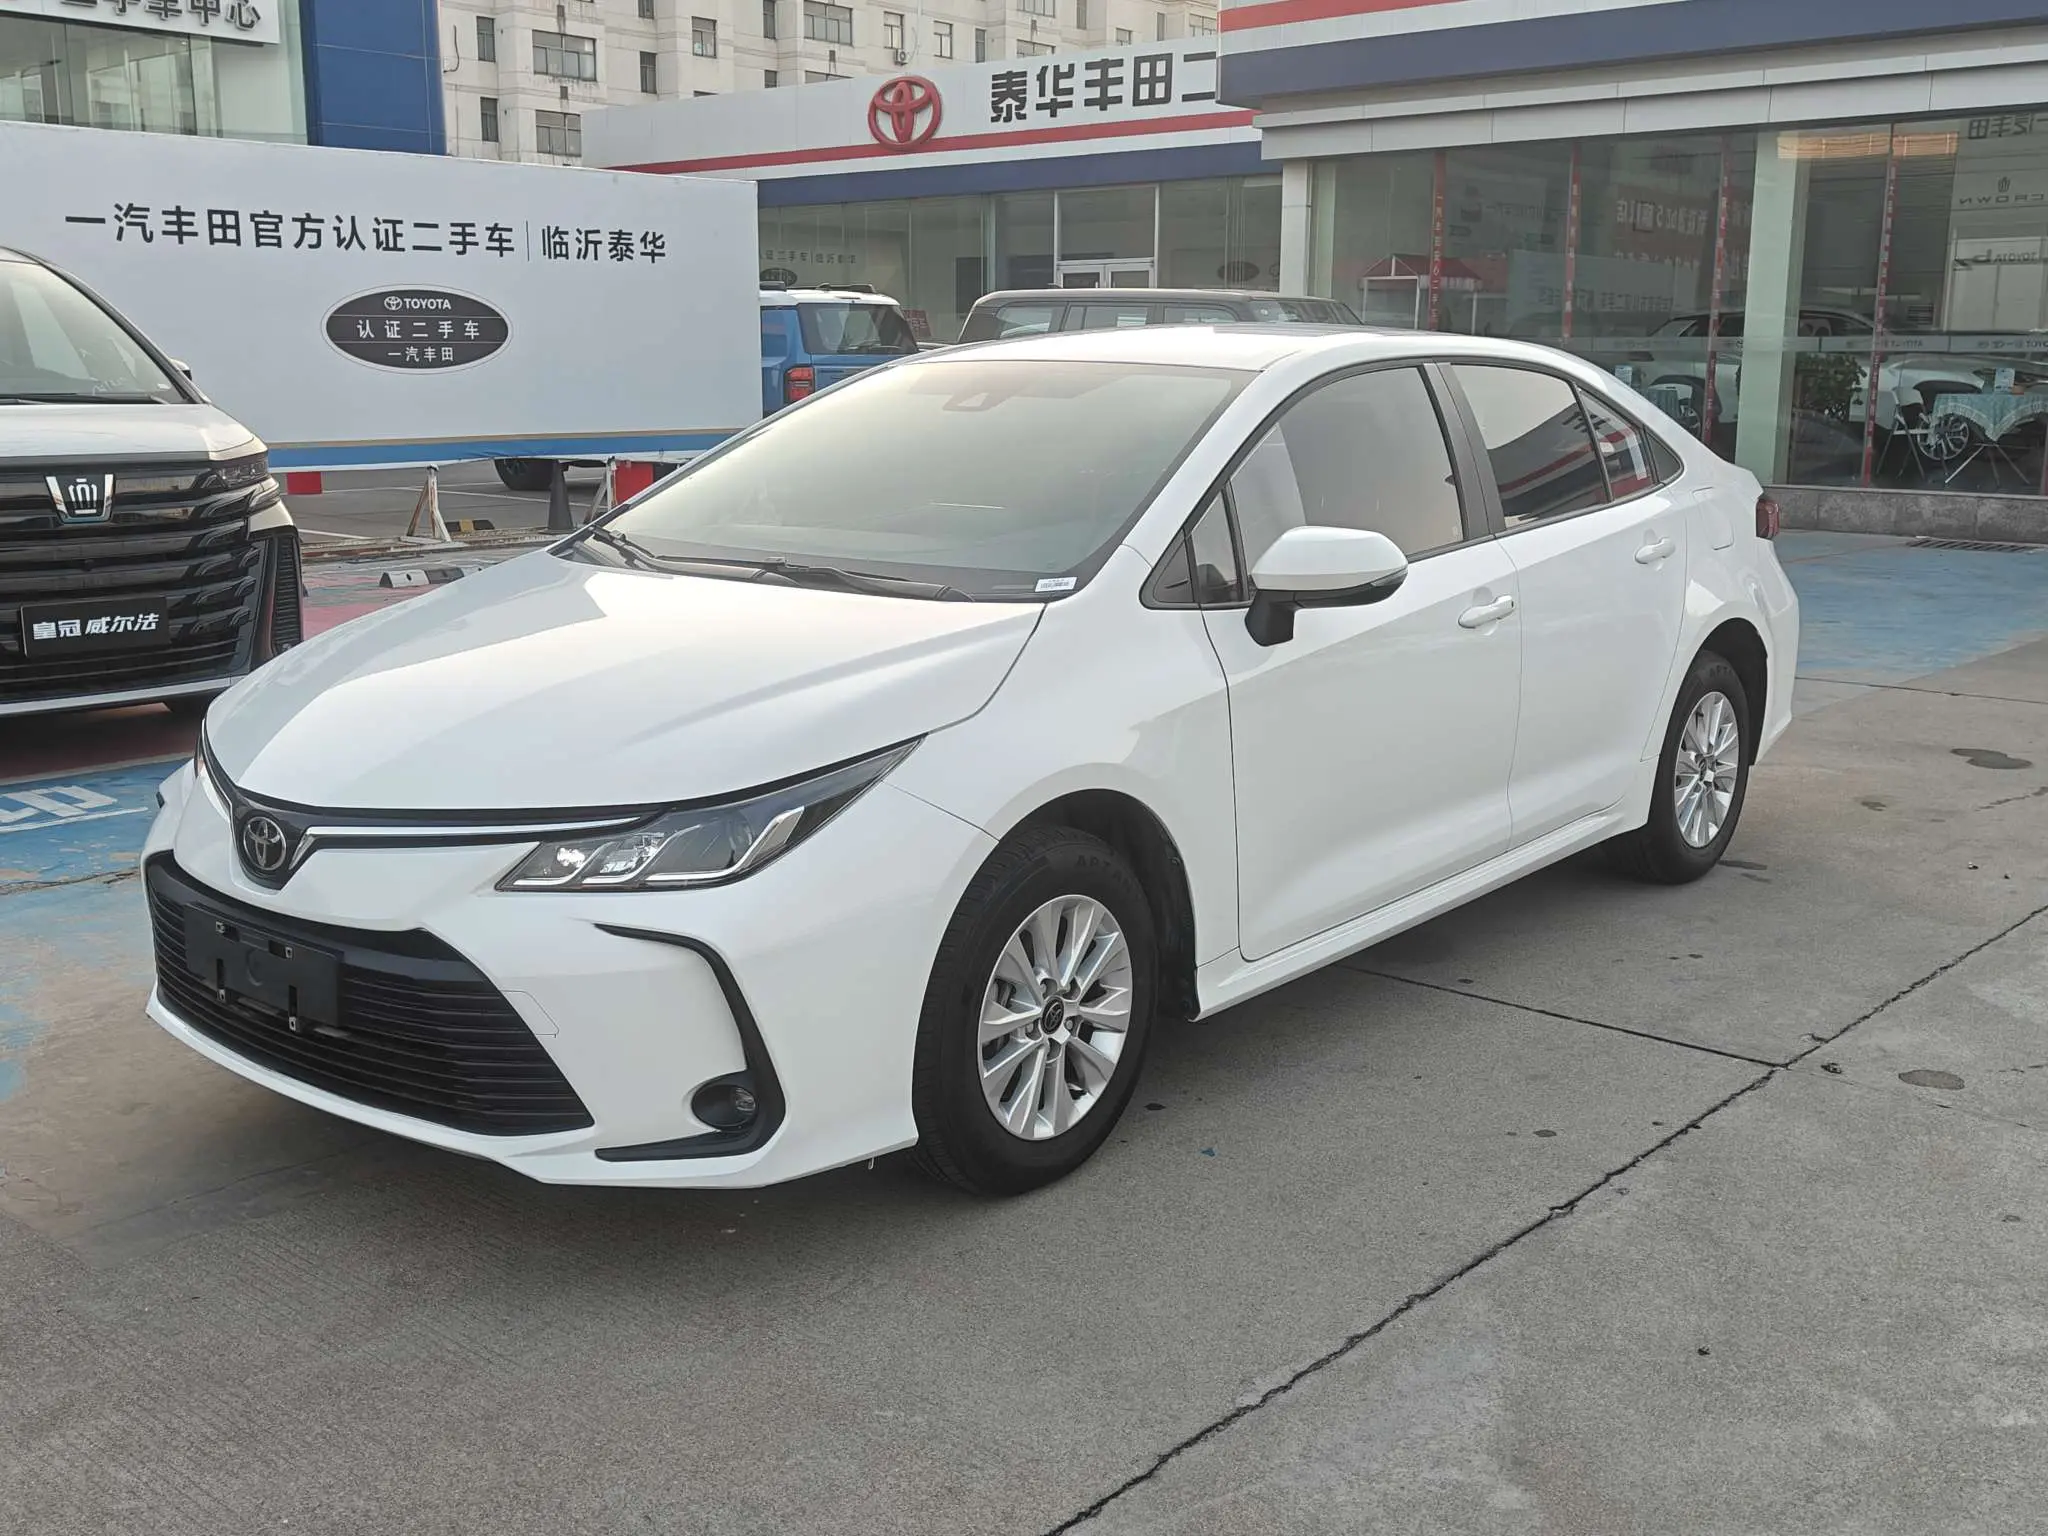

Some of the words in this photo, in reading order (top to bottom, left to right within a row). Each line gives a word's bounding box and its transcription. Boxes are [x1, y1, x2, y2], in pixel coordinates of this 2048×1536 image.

[990, 51, 1216, 123] 泰华丰田二
[65, 202, 515, 258] 一汽丰田官方认证二手车
[541, 225, 666, 263] 临沂泰华
[404, 298, 451, 310] TOYOTA
[357, 319, 480, 340] 认证二手车
[388, 346, 454, 362] 一汽丰田
